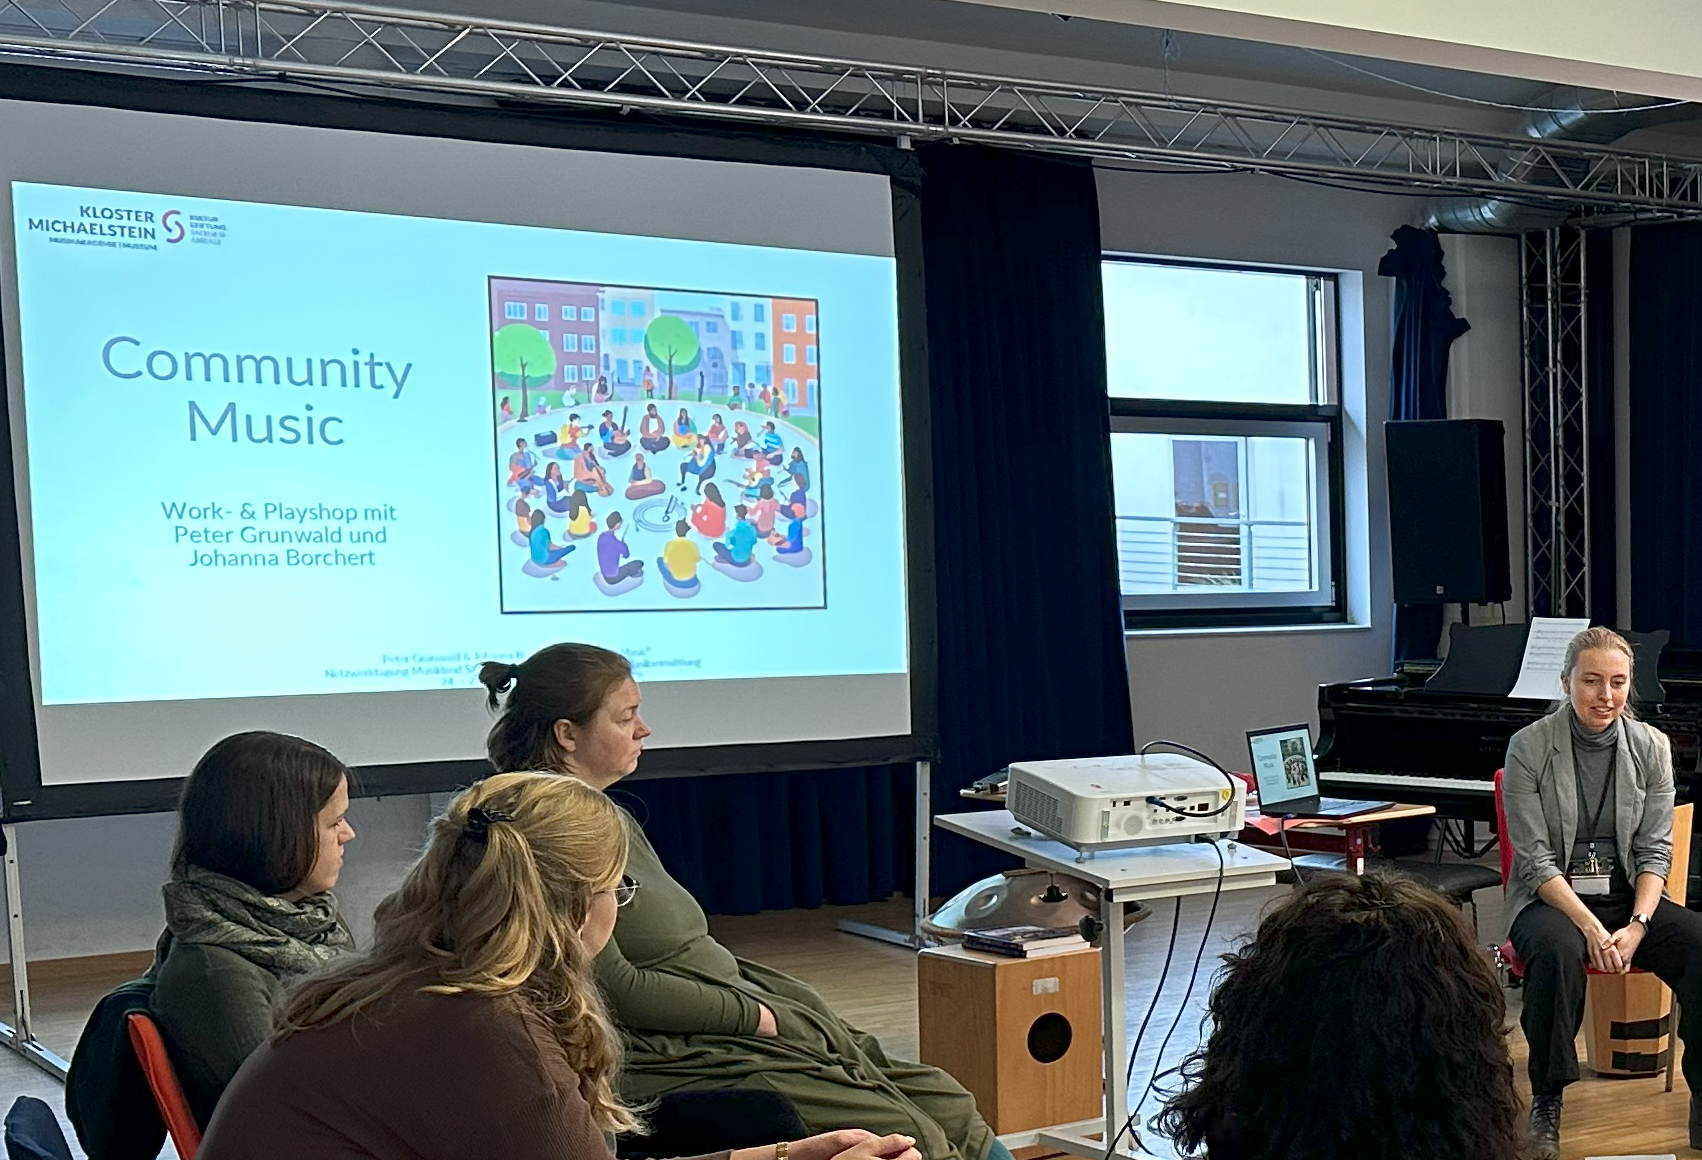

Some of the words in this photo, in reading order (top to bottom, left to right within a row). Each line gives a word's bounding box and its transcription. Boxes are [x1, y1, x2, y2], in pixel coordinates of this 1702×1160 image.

[79, 205, 156, 223] KLOSTER
[28, 217, 156, 240] MICHAELSTEIN
[101, 335, 413, 399] Community
[188, 400, 345, 446] Music
[160, 501, 233, 520] Work-
[240, 502, 257, 520] &
[264, 501, 358, 524] Playshop
[364, 503, 397, 520] mit
[174, 525, 234, 544] Peter
[240, 525, 342, 544] Grunwald
[349, 526, 387, 544] und
[188, 548, 279, 567] Johanna
[286, 548, 376, 566] Borchert
